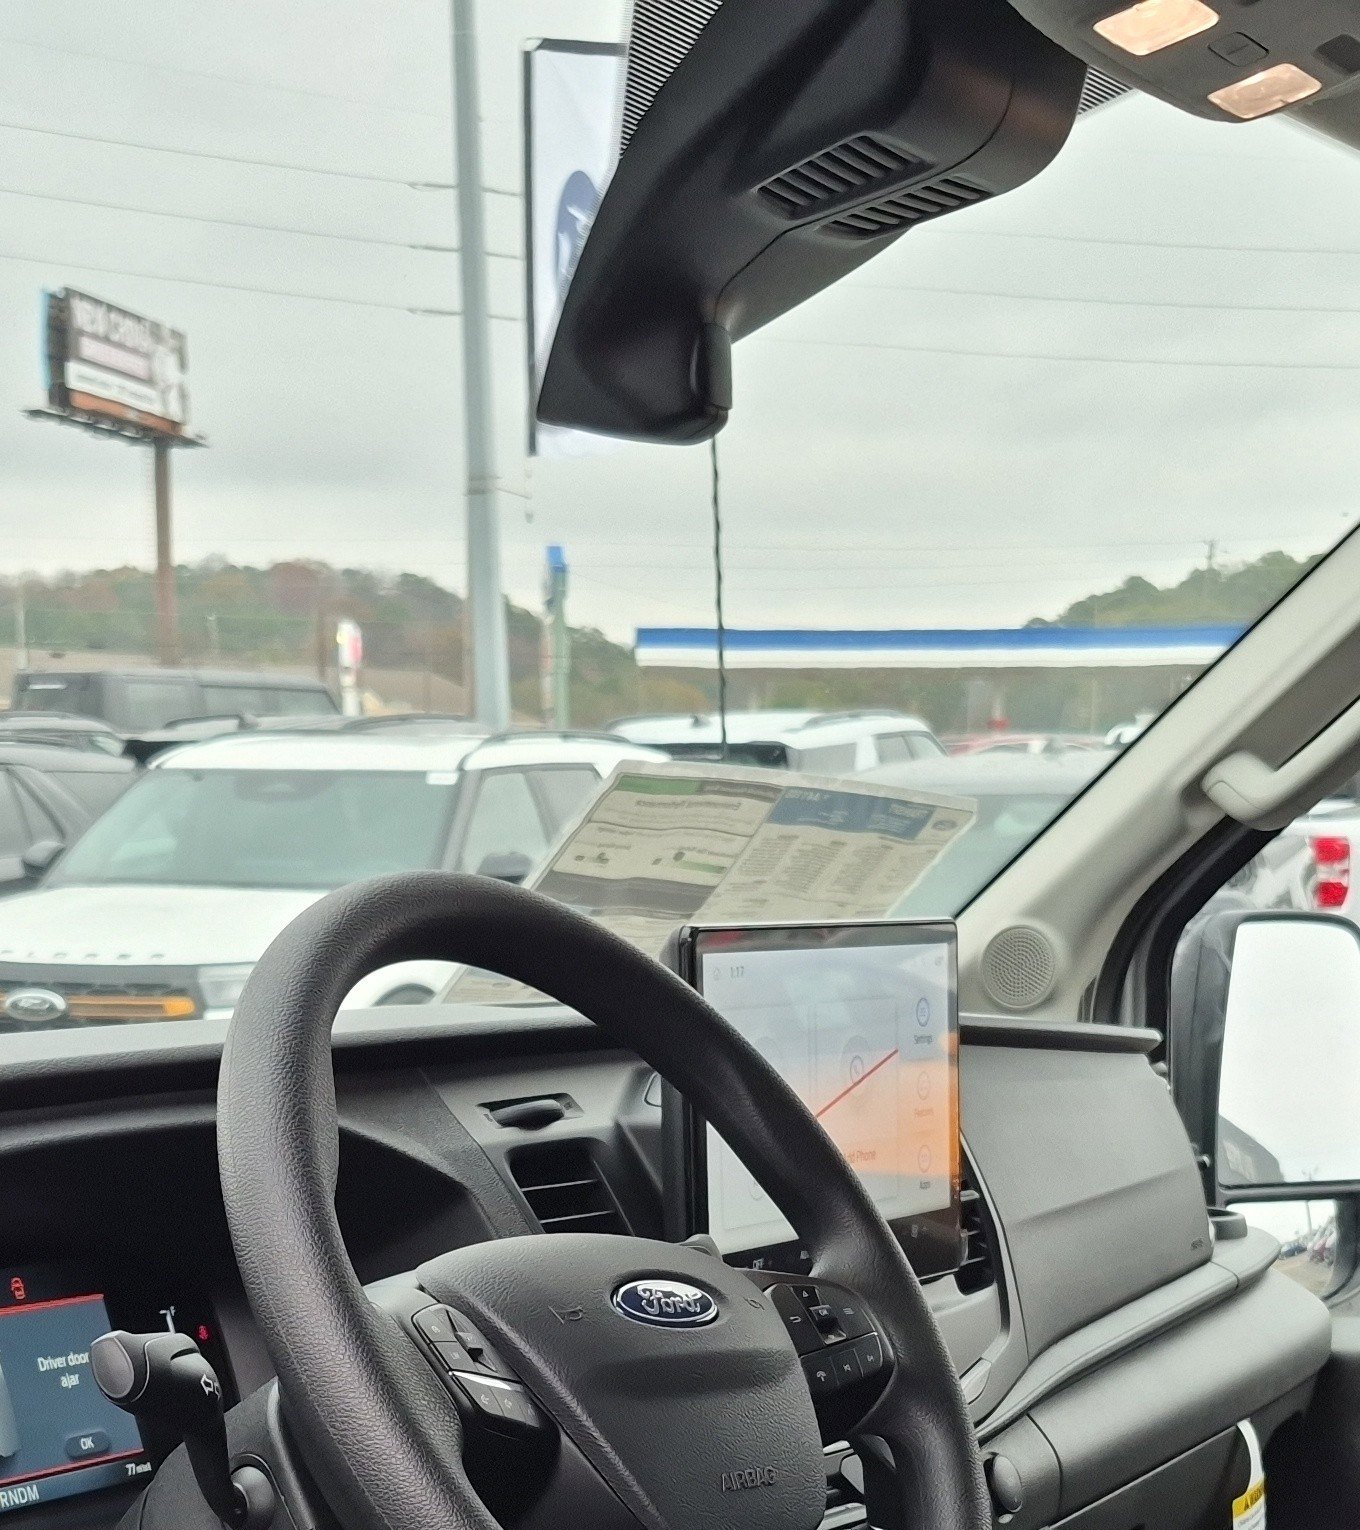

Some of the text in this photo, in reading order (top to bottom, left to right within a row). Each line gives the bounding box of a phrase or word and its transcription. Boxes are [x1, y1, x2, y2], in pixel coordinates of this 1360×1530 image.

[636, 1283, 703, 1315] Ford
[37, 1351, 90, 1372] Driver door
[60, 1372, 80, 1389] ajar
[80, 1436, 95, 1450] OK
[721, 1465, 779, 1493] AIRBAG
